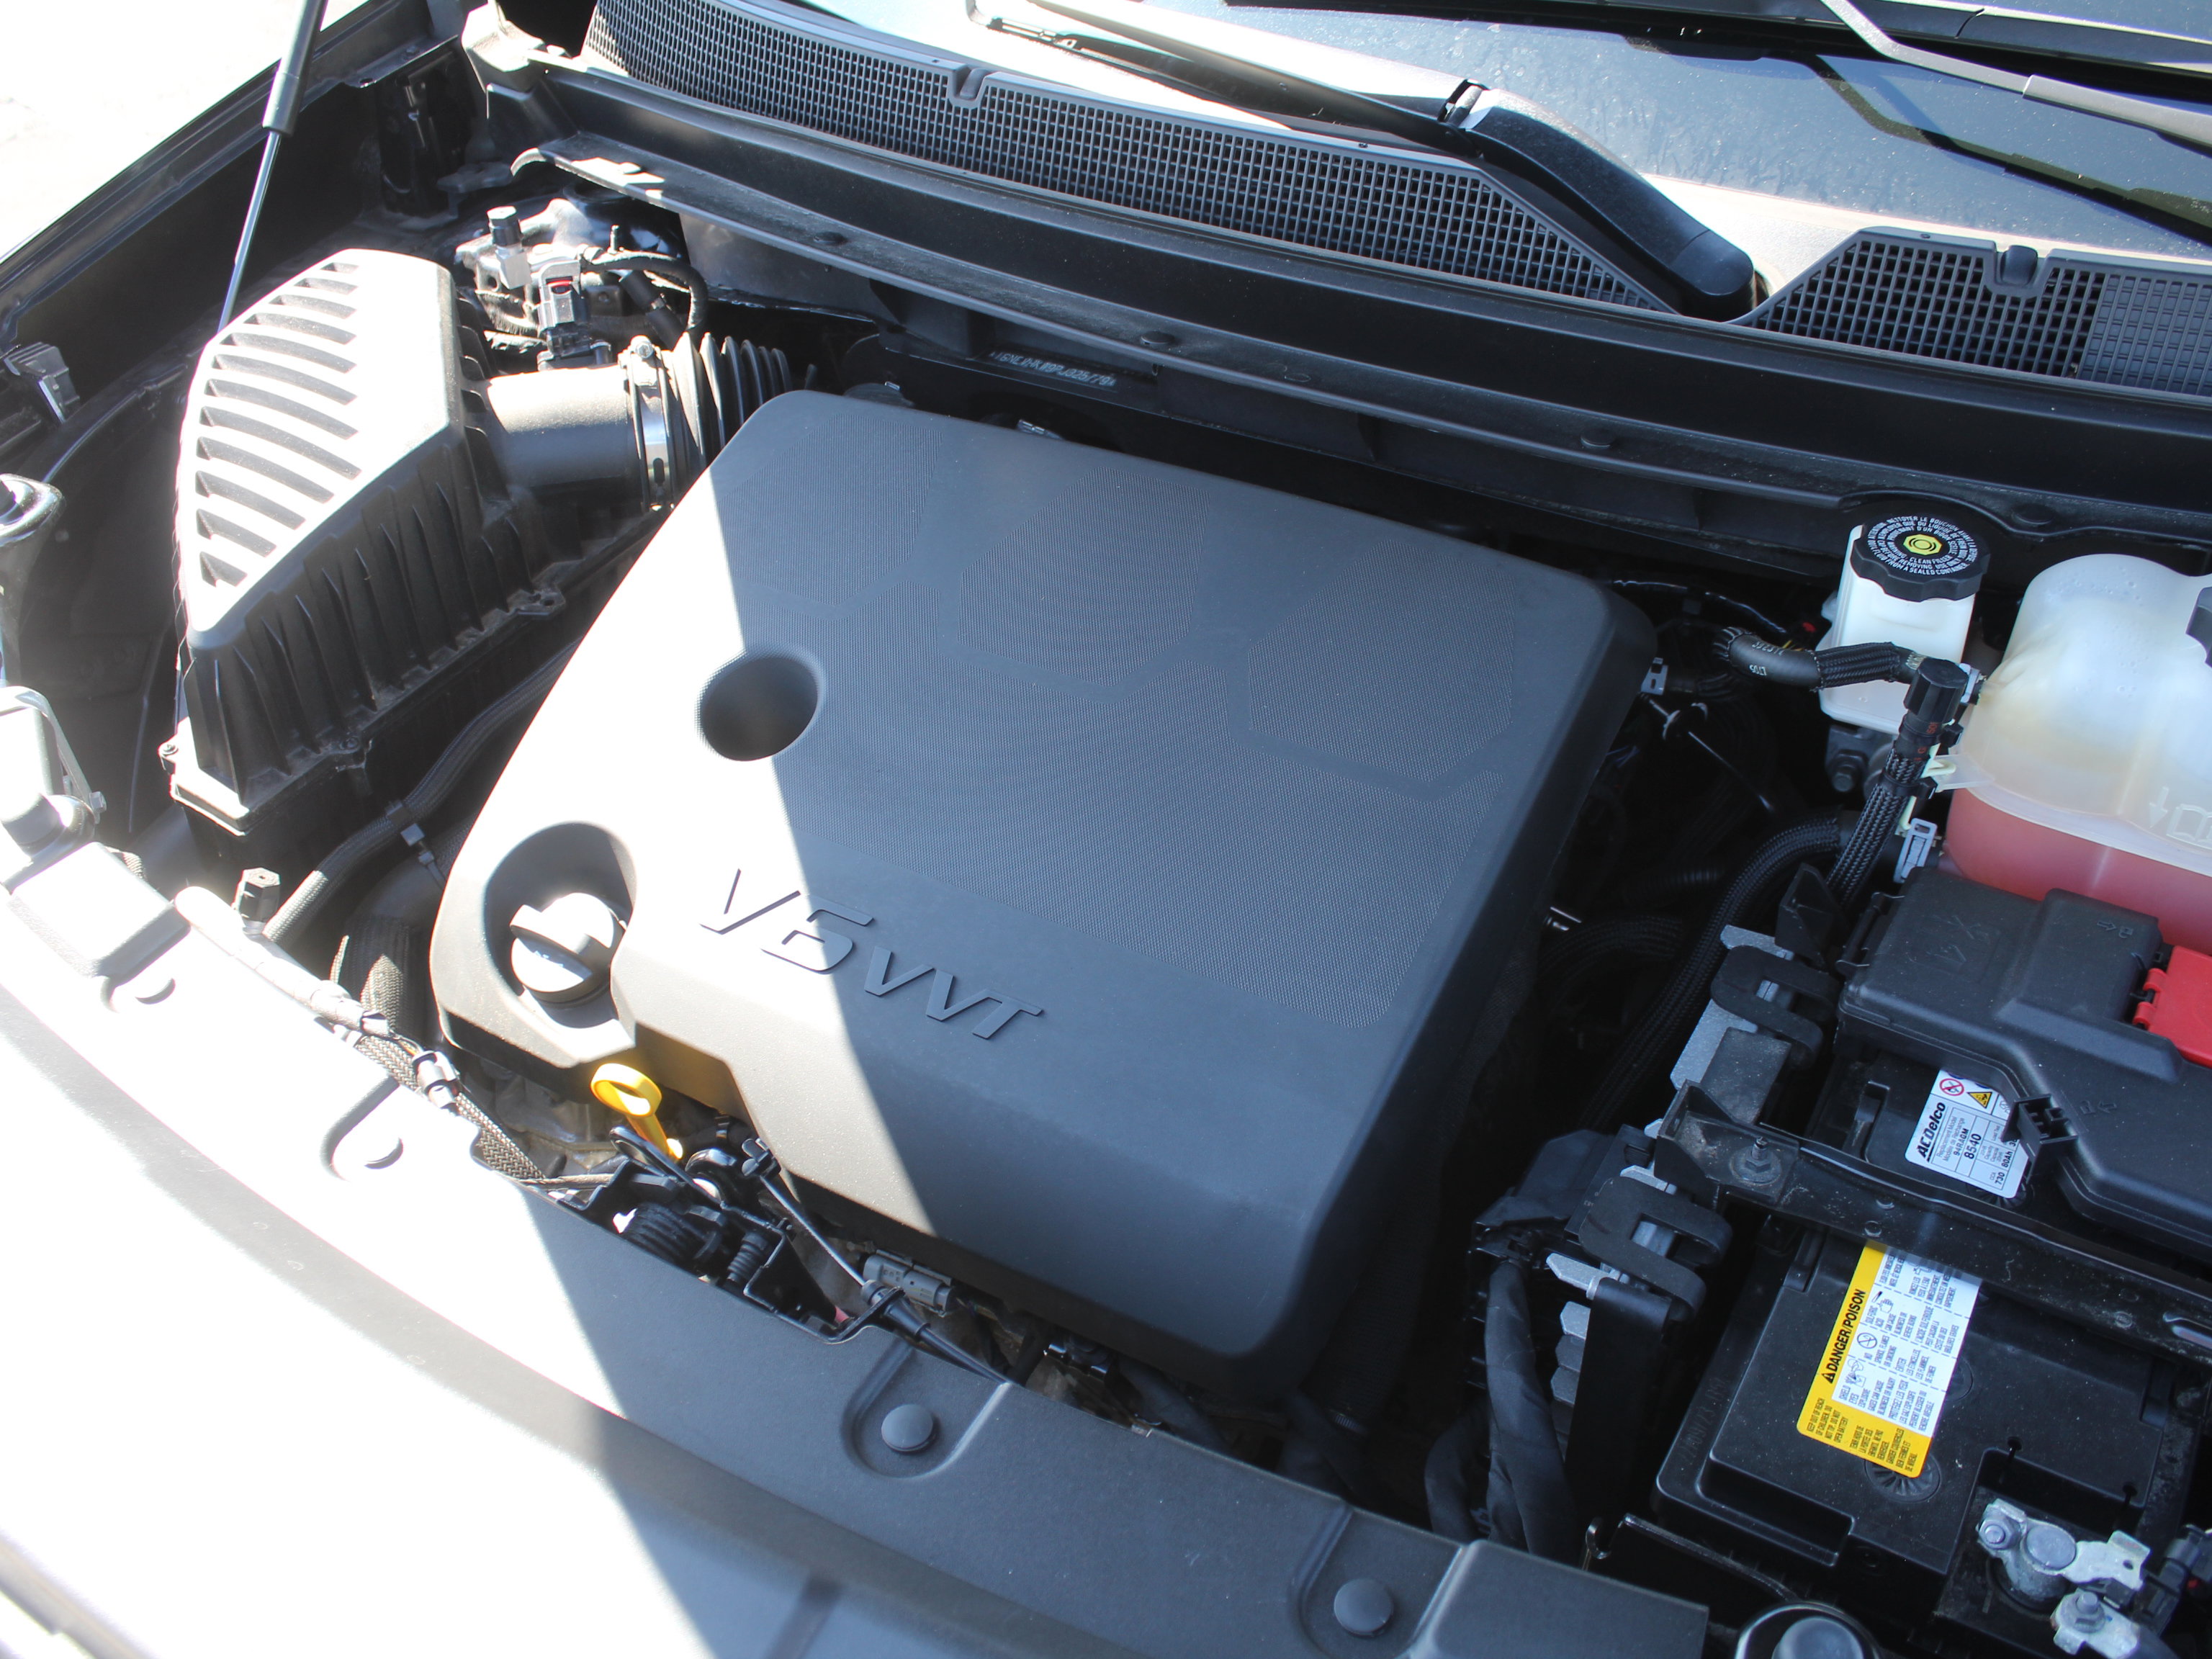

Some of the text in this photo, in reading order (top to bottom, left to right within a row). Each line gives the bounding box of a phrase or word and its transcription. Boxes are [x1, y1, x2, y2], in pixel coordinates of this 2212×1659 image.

[1928, 523, 1952, 534] LIQUIDE
[1930, 518, 1959, 531] BOUCHON
[1933, 530, 1952, 541] BIDON
[1884, 559, 1904, 570] FROM
[1909, 567, 1936, 575] SEALED
[864, 945, 1043, 1040] VVT
[1917, 1102, 1946, 1158] ACDelco
[1953, 1128, 1968, 1155] 94RAGM
[1964, 1133, 1981, 1159] 8540
[2001, 1150, 2012, 1167] 80Ah
[1995, 1172, 2005, 1184] 730
[1825, 1289, 1866, 1372] DANGER/POISON
